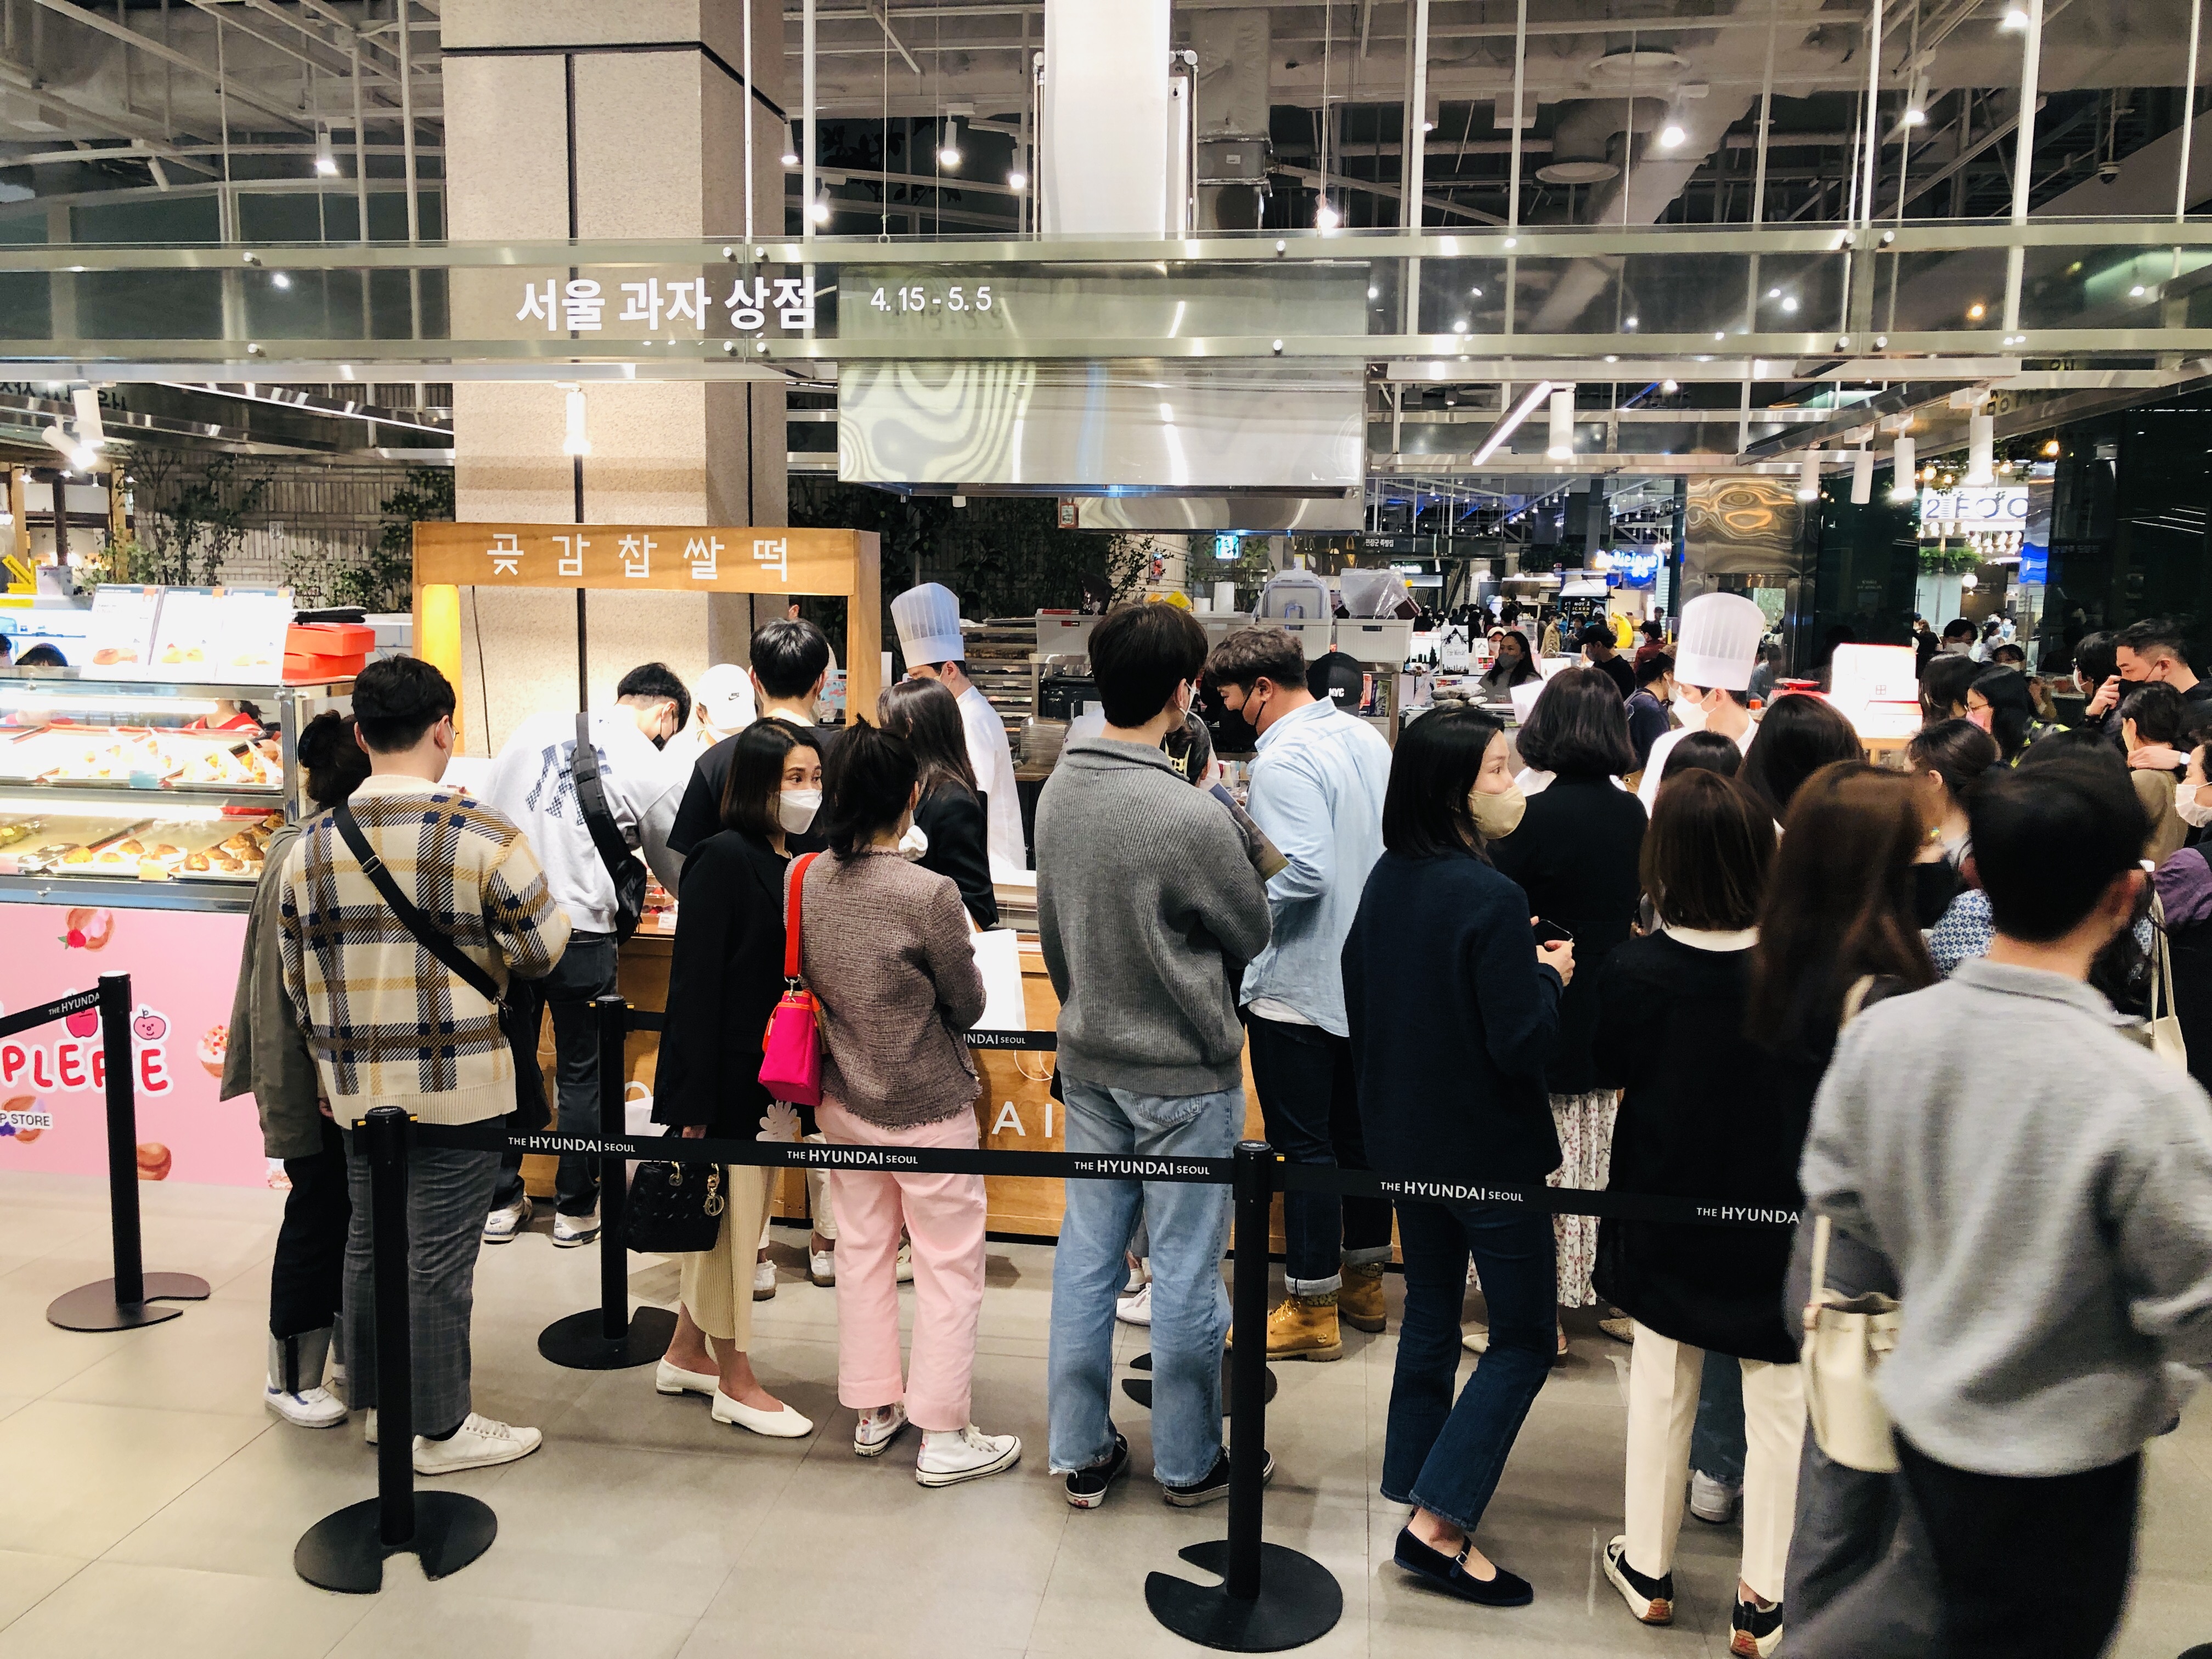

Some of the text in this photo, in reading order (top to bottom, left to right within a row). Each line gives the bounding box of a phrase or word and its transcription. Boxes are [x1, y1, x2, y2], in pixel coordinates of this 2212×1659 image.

[516, 276, 815, 331] 서울 과자 상점
[1328, 687, 1345, 697] NYC
[48, 992, 100, 1015] THE HYUNDA
[963, 1033, 998, 1045] NDAI
[2, 1043, 168, 1092] PLEE
[11, 1114, 50, 1127] STORE
[508, 1136, 636, 1152] THE HYUNDAI SEOUL
[787, 1149, 918, 1165] THE HYUNDAI SEOUL
[1074, 1160, 1210, 1175] THE HYUNDAI SEOUL
[1380, 1181, 1523, 1202] THE HYUNDAI SEOUL
[1696, 1206, 1800, 1224] THE HYUNDA
